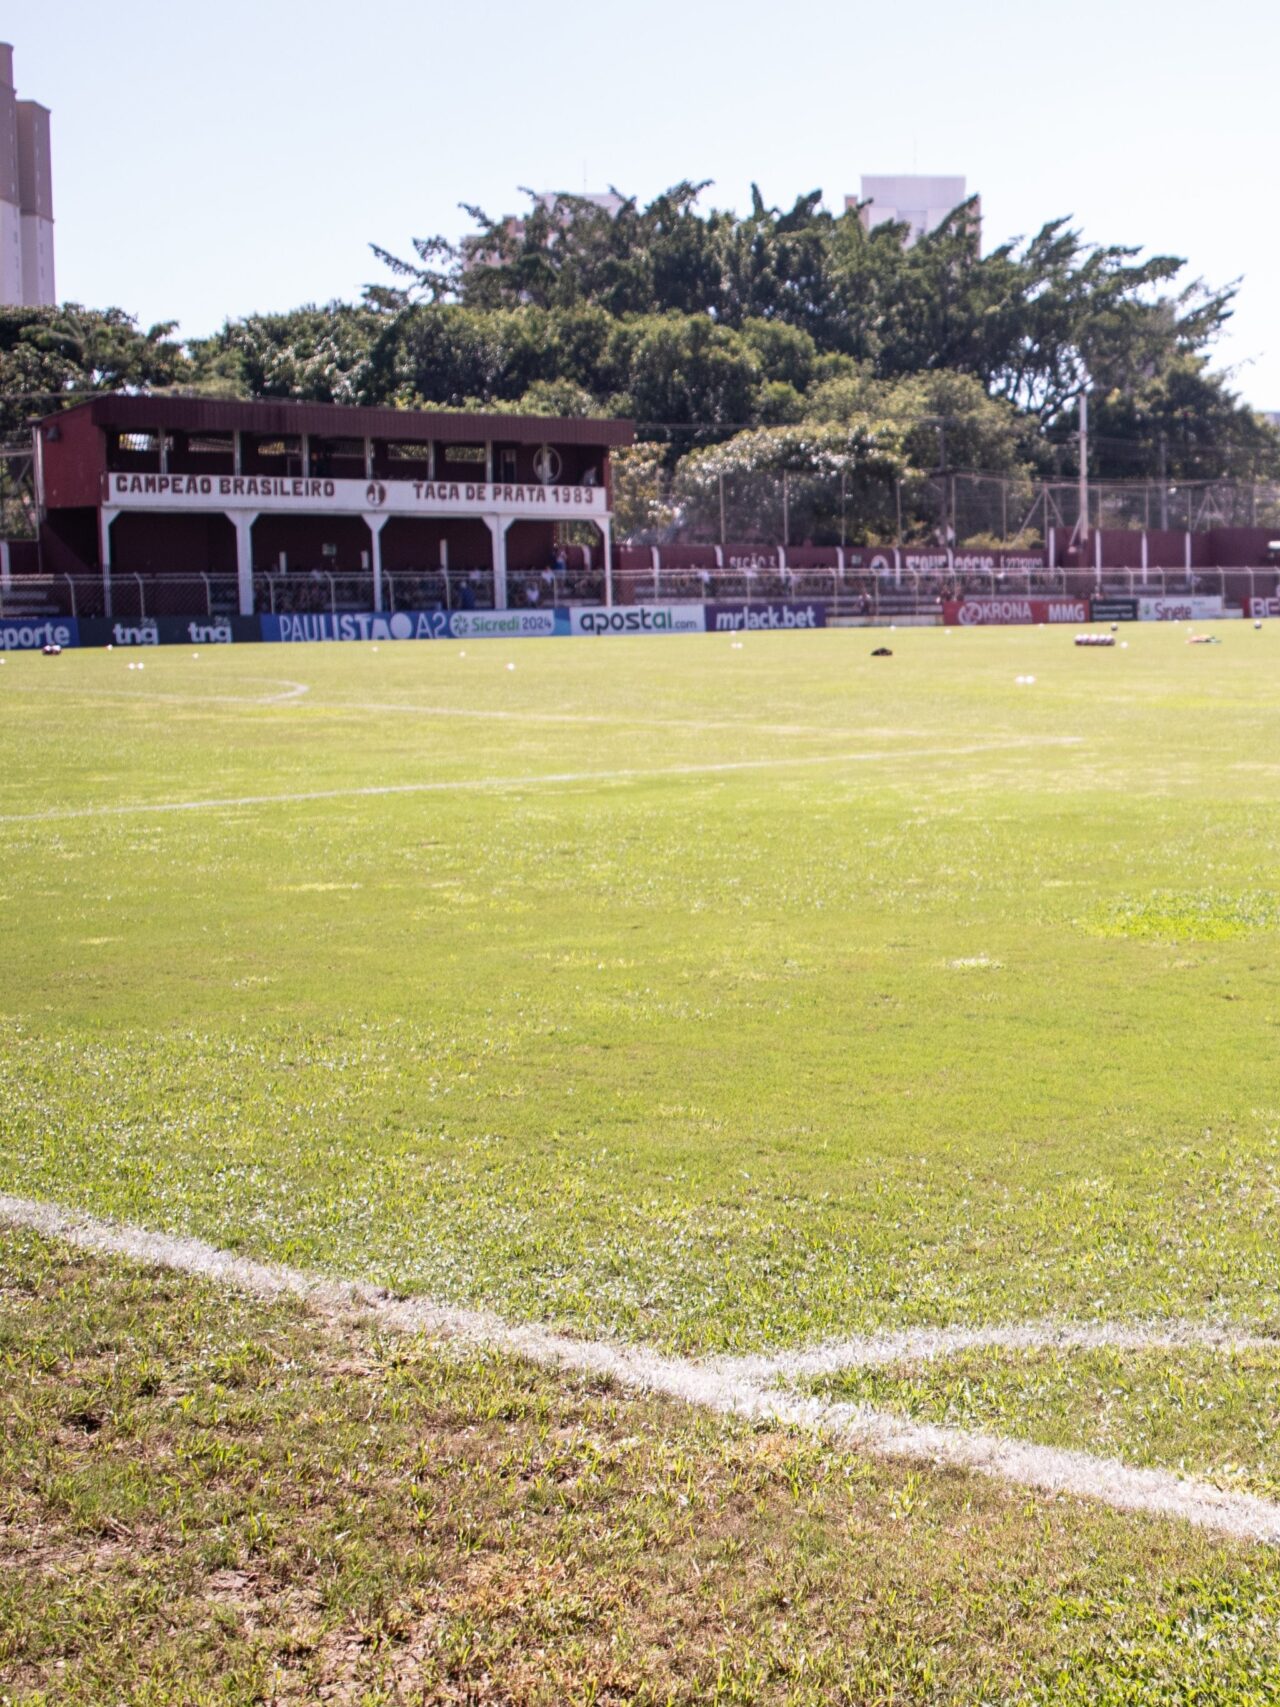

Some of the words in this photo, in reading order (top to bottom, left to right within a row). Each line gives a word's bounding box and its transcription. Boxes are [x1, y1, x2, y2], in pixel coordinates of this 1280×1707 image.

[219, 477, 335, 497] BRASILEIRO
[465, 484, 486, 501] DE
[493, 485, 546, 503] PRATA
[552, 487, 593, 504] 1983
[982, 602, 1032, 619] KRONA
[1048, 604, 1085, 622] MMG
[113, 622, 158, 645] tng
[188, 621, 232, 643] tng
[415, 611, 448, 639] A2
[471, 616, 520, 632] Sicredi
[522, 616, 552, 630] 2024
